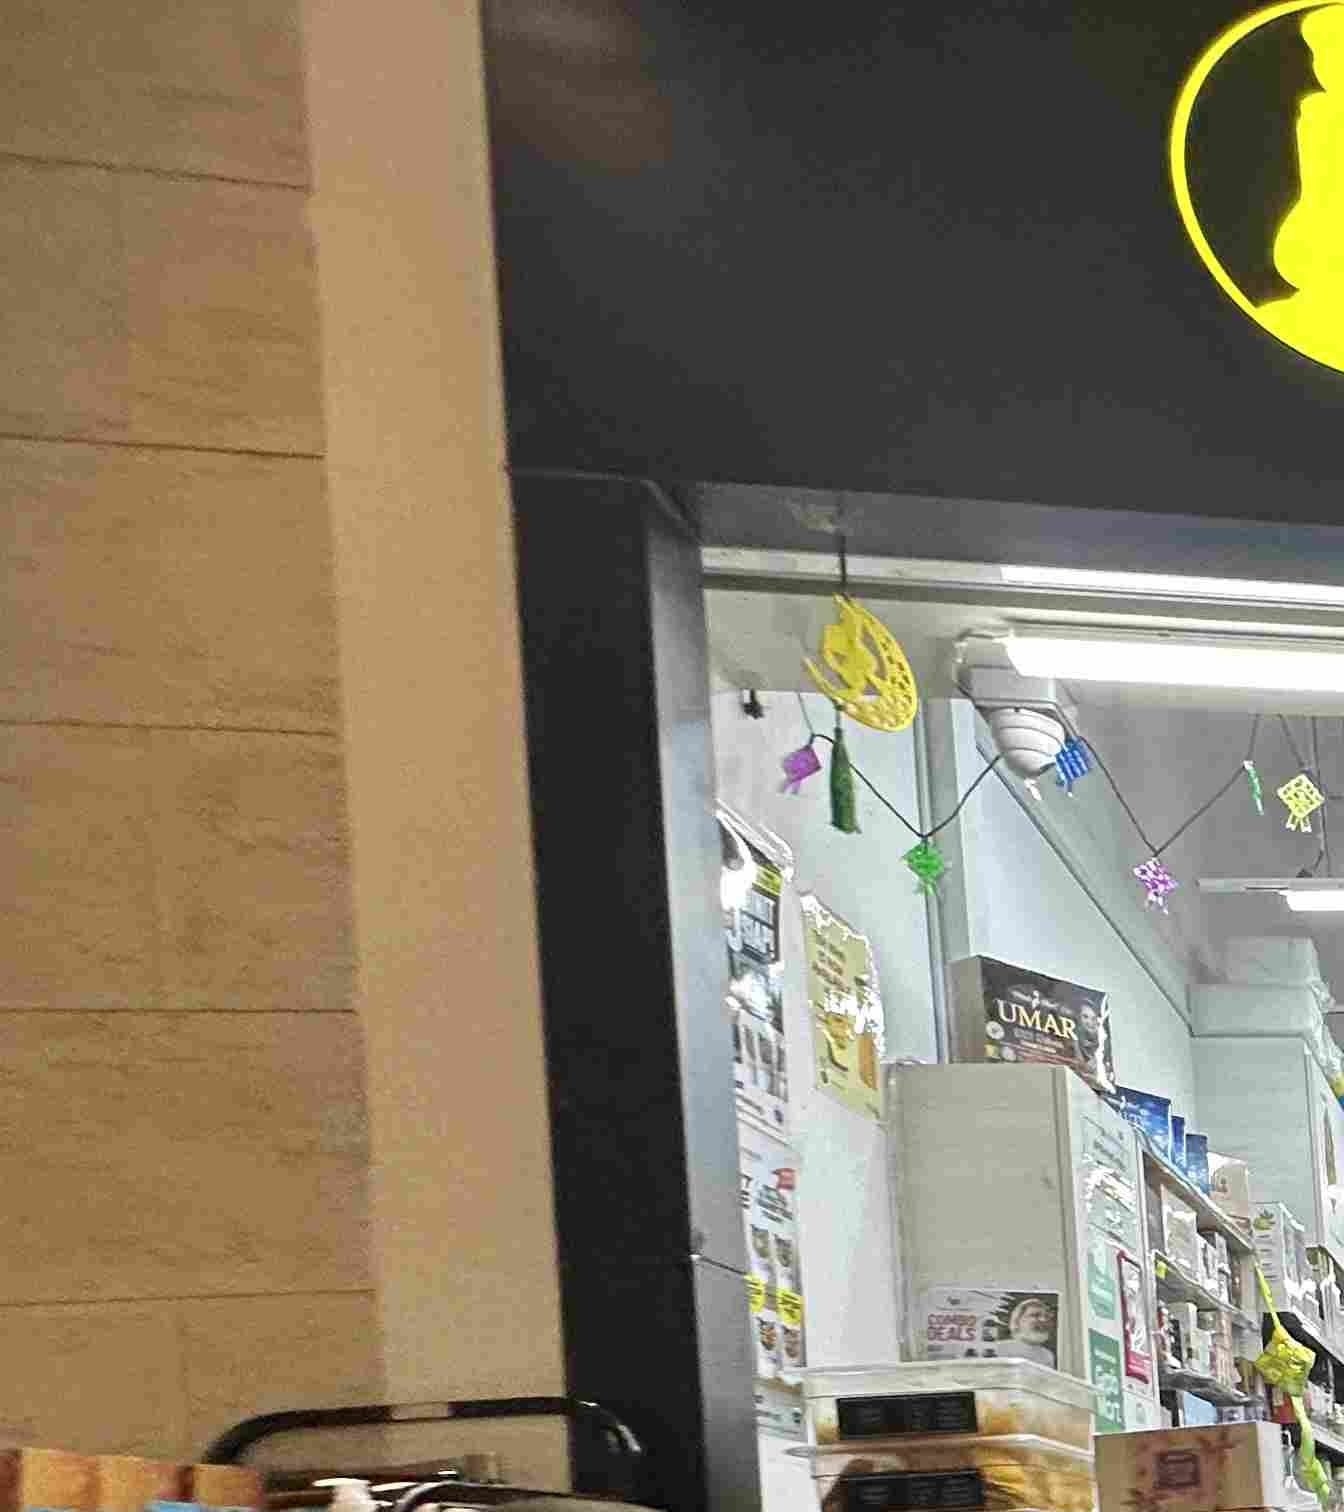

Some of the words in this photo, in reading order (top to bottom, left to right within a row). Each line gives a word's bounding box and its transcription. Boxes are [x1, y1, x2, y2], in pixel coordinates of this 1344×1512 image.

[993, 998, 1078, 1041] UMAR
[927, 1312, 977, 1327] COMBO
[927, 1326, 977, 1342] DEALS
